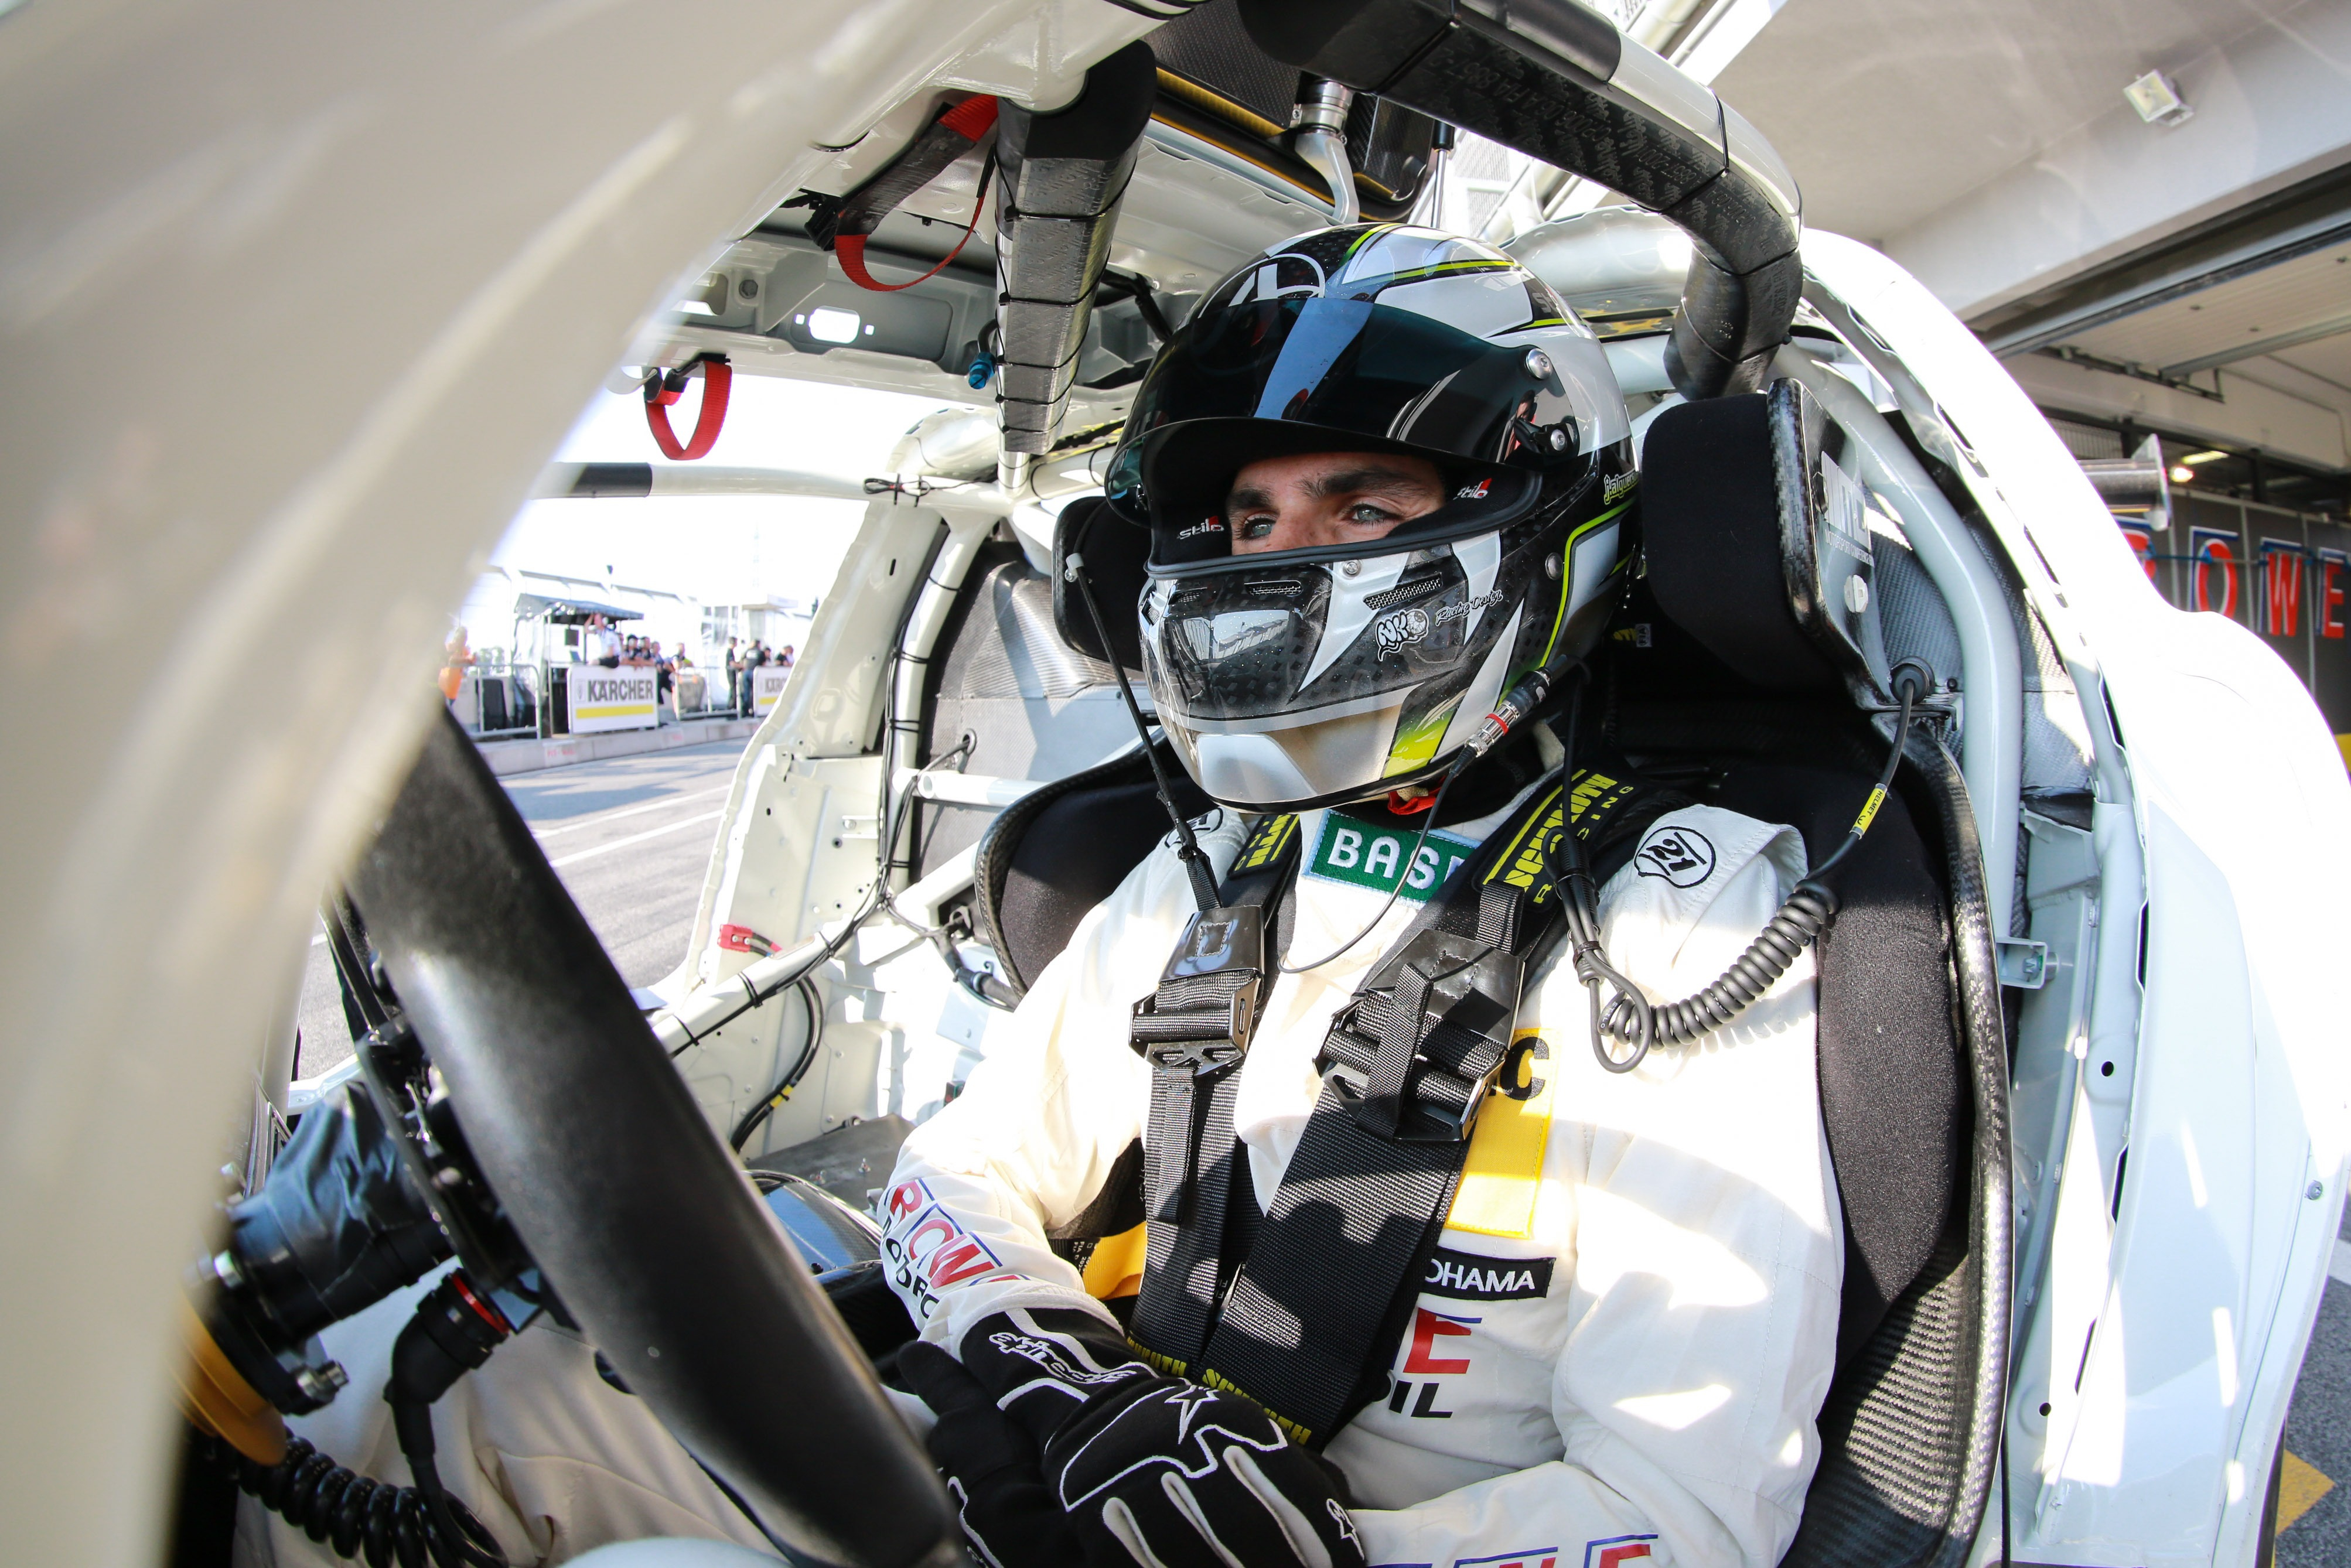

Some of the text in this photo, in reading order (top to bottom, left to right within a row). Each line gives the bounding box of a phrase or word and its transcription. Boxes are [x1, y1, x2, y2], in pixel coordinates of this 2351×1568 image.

[1436, 589, 1503, 626] Racing Design
[588, 679, 653, 702] KÄRCHER
[1867, 791, 1883, 816] HELMET
[1533, 785, 1634, 904] RCING
[1388, 1379, 1453, 1419] IL
